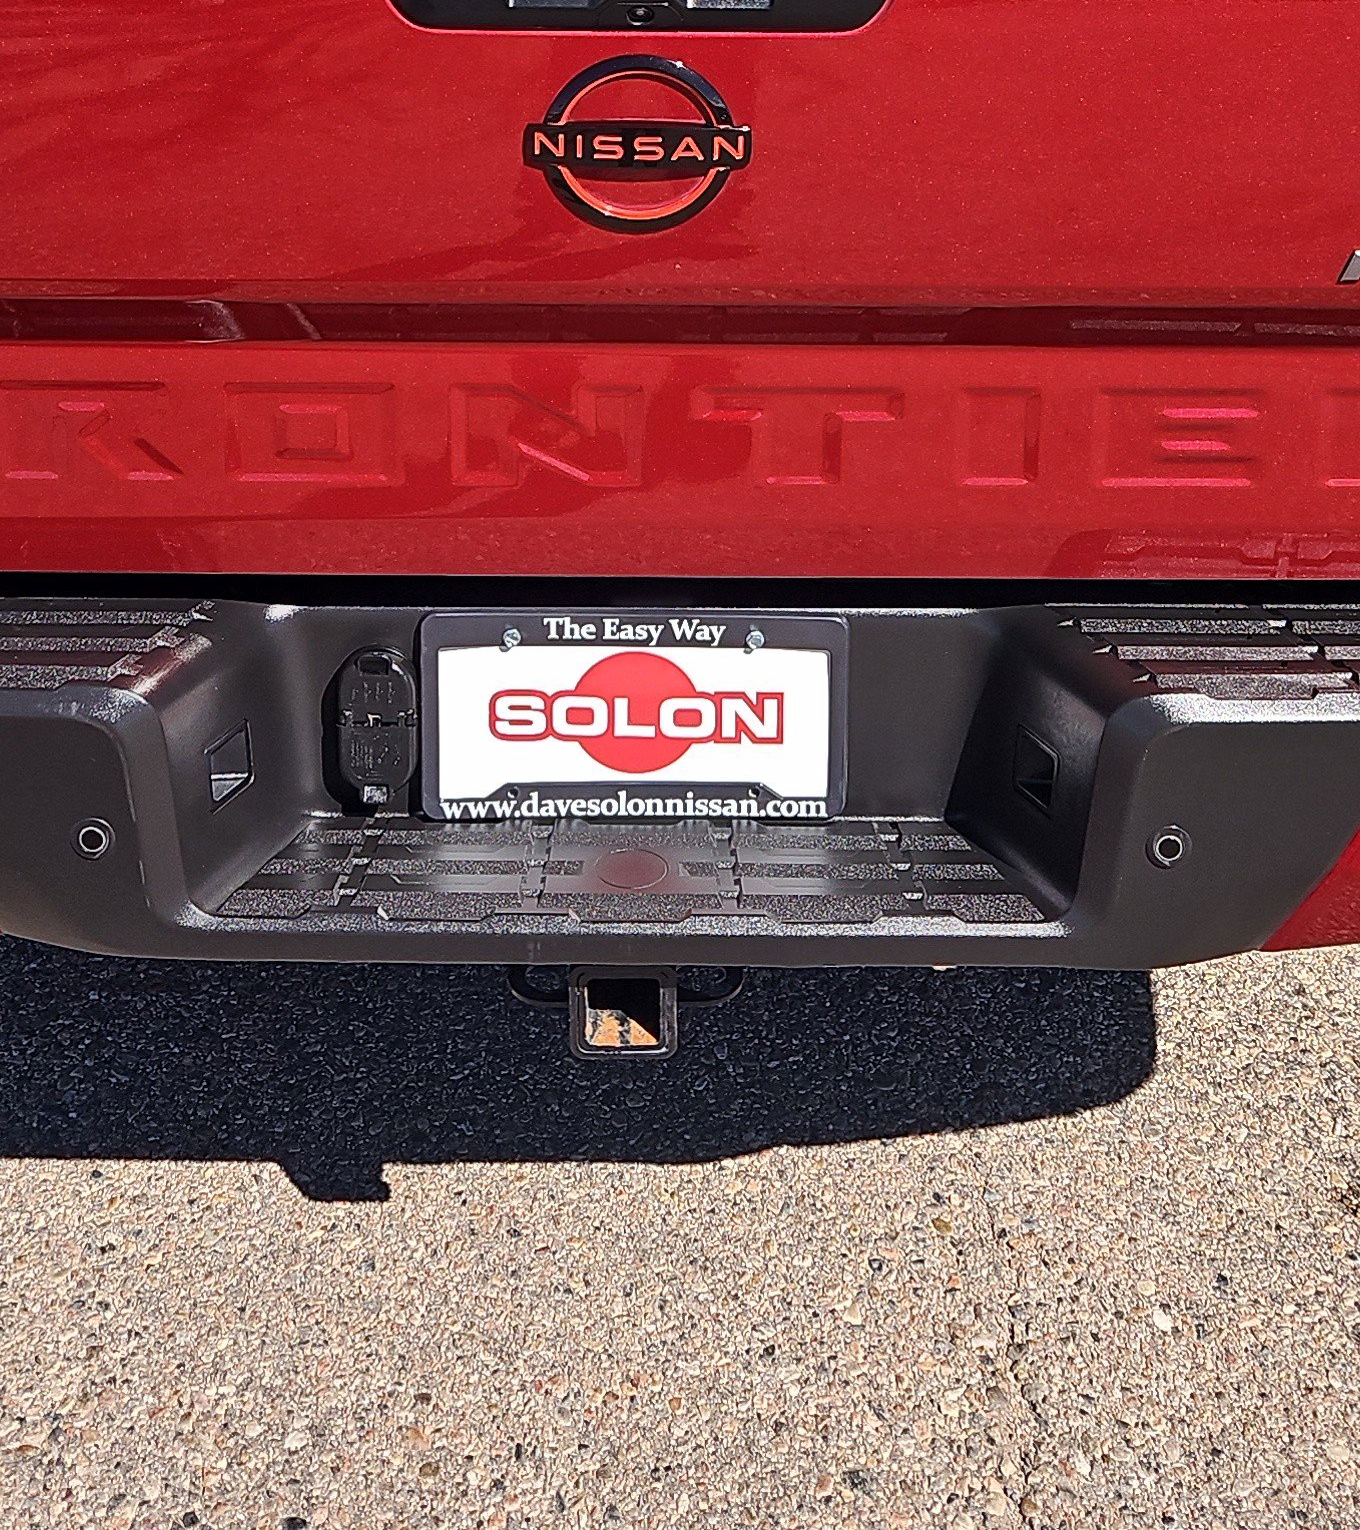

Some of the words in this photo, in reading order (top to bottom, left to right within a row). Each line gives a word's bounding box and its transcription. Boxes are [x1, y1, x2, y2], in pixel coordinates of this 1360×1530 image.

[533, 131, 745, 161] NISSAN
[543, 617, 597, 641] The
[601, 618, 665, 646] Easy
[668, 618, 727, 646] Way
[489, 689, 785, 744] SOLON
[441, 791, 828, 819] www.davesolonnissan.com
